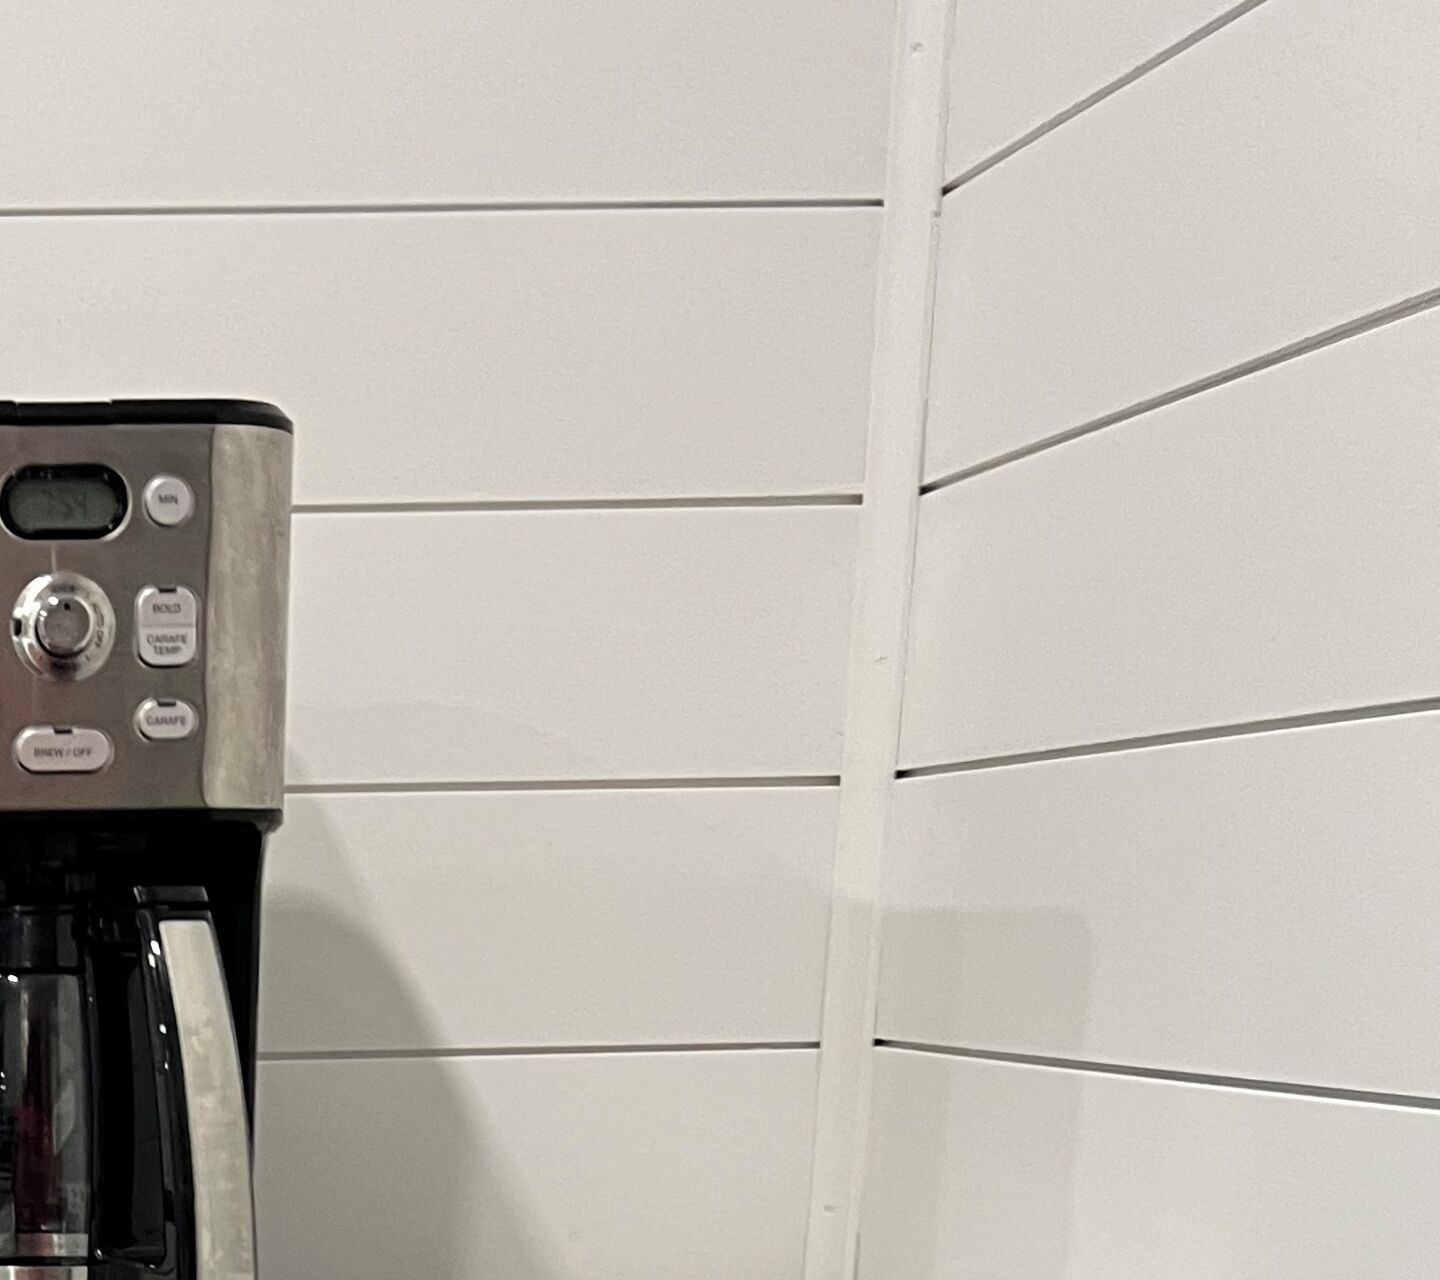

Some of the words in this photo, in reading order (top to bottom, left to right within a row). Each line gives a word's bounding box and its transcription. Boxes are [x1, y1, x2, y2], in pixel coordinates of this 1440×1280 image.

[158, 493, 179, 505] MIN
[152, 603, 182, 614] BOLD
[146, 633, 188, 645] CARAFE
[153, 645, 182, 655] TEMP
[145, 715, 187, 727] CARAFE
[33, 746, 64, 758] BREW
[72, 746, 93, 758] OFF
